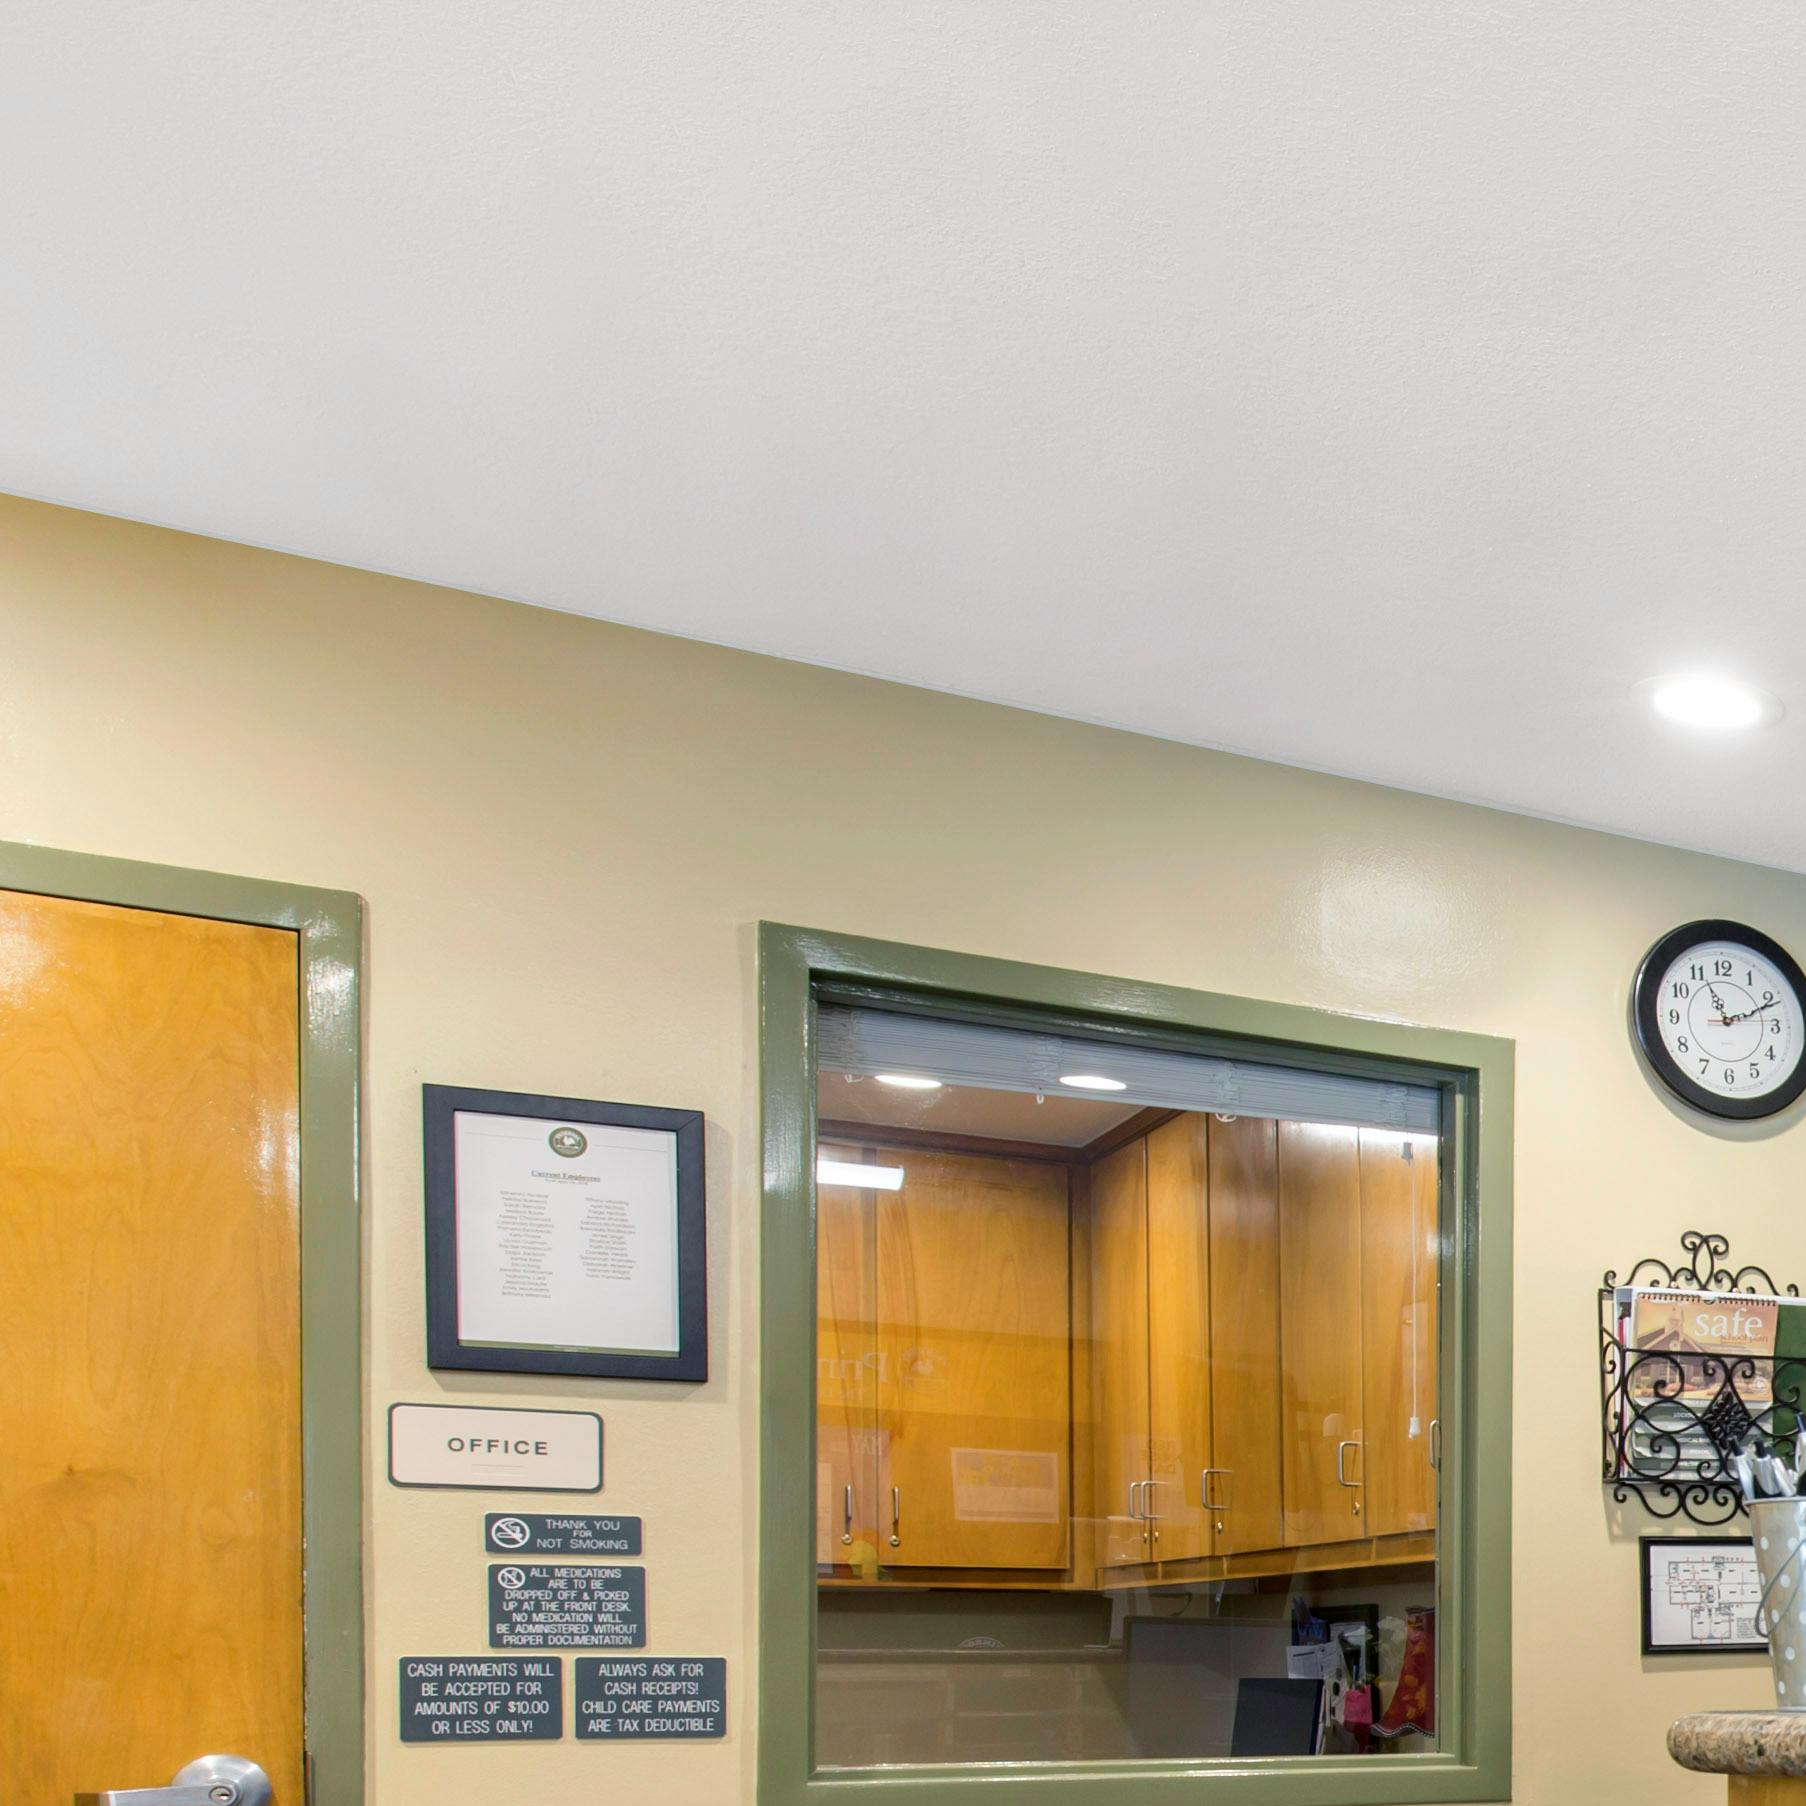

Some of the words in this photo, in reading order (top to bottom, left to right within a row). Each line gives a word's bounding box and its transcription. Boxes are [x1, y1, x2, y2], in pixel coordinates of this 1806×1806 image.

[1690, 964, 1704, 980] 11
[1714, 960, 1732, 976] 12
[1746, 970, 1752, 986] 1
[1672, 982, 1689, 998] 10
[1763, 991, 1774, 1008] 2
[1670, 1009, 1679, 1024] 9
[1771, 1019, 1780, 1034] 3
[1678, 1036, 1688, 1052] 8
[1765, 1045, 1776, 1060] 4
[1699, 1059, 1709, 1074] 7
[1750, 1063, 1759, 1078] 5
[1725, 1068, 1734, 1084] 6
[1694, 1307, 1763, 1340] safe
[447, 1438, 549, 1456] OFFICE
[545, 1519, 588, 1530] THANK
[594, 1520, 620, 1531] YOU
[536, 1538, 562, 1549] NOT
[570, 1539, 628, 1550] SMOKING
[530, 1568, 550, 1578] ALL
[554, 1568, 622, 1579] MEDICATIONS
[548, 1579, 569, 1589] ARE
[574, 1579, 588, 1589] TO
[592, 1579, 604, 1589] BE
[505, 1590, 553, 1601] DROPPED
[557, 1590, 579, 1601] OFF
[583, 1591, 591, 1601] &
[594, 1590, 629, 1601] PICKED
[503, 1601, 518, 1612] UP
[521, 1601, 537, 1612] AT
[541, 1601, 559, 1612] THE
[563, 1601, 598, 1612] FRONT
[602, 1602, 631, 1612] DESK.
[512, 1613, 528, 1623] NO
[532, 1613, 593, 1623] MEDICATION
[597, 1613, 622, 1623] WILL
[496, 1624, 511, 1634] BE
[515, 1624, 589, 1634] ADMINISTERED
[594, 1624, 637, 1634] WITHOUT
[503, 1635, 543, 1645] PROPER
[548, 1635, 633, 1646] DOCUMENTATION
[407, 1664, 443, 1677] CASH
[449, 1664, 517, 1677] PAYMENTS
[524, 1663, 554, 1677] WILL
[598, 1664, 647, 1677] ALWAYS
[652, 1664, 676, 1677] ASK
[681, 1664, 704, 1676] FOR
[421, 1683, 438, 1696] BE
[445, 1683, 511, 1696] ACCEPTED
[517, 1682, 542, 1695] FOR
[604, 1682, 636, 1695] CASH
[642, 1682, 699, 1695] RECEIPTS!
[414, 1702, 478, 1715] AMOUNTS
[484, 1702, 501, 1715] OF
[508, 1700, 549, 1715] $10.00
[581, 1701, 617, 1714] CHILD
[622, 1701, 652, 1714] CARE
[658, 1700, 720, 1713] PAYMENTS
[432, 1721, 450, 1734] OR
[456, 1721, 490, 1734] LESS
[496, 1720, 533, 1734] ONLY!
[588, 1719, 612, 1732] ARE
[618, 1719, 639, 1732] TAX
[645, 1718, 714, 1732] DEDUCTIBLE
